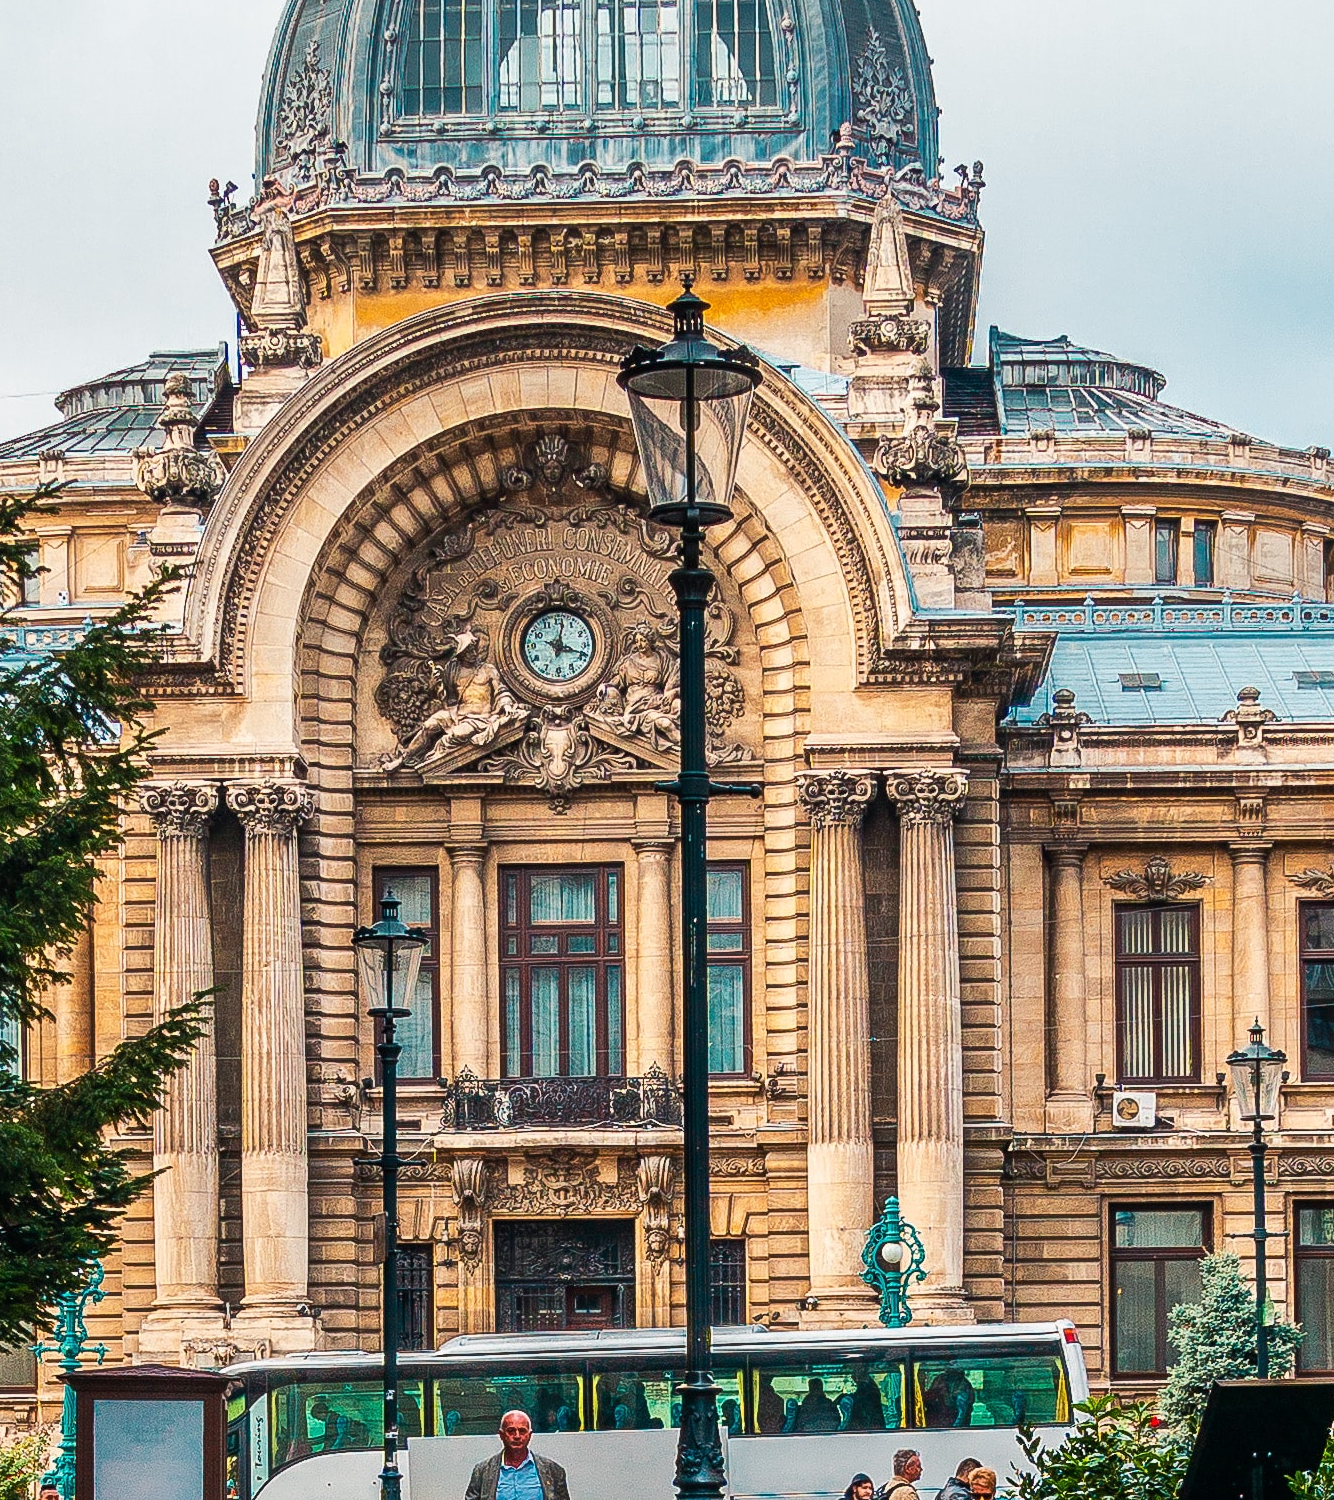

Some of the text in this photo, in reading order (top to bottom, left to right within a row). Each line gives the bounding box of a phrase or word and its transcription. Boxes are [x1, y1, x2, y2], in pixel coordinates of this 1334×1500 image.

[467, 527, 554, 577] DEPUNERI
[509, 557, 614, 587] ECONOMIE
[255, 1415, 264, 1469] Touring
